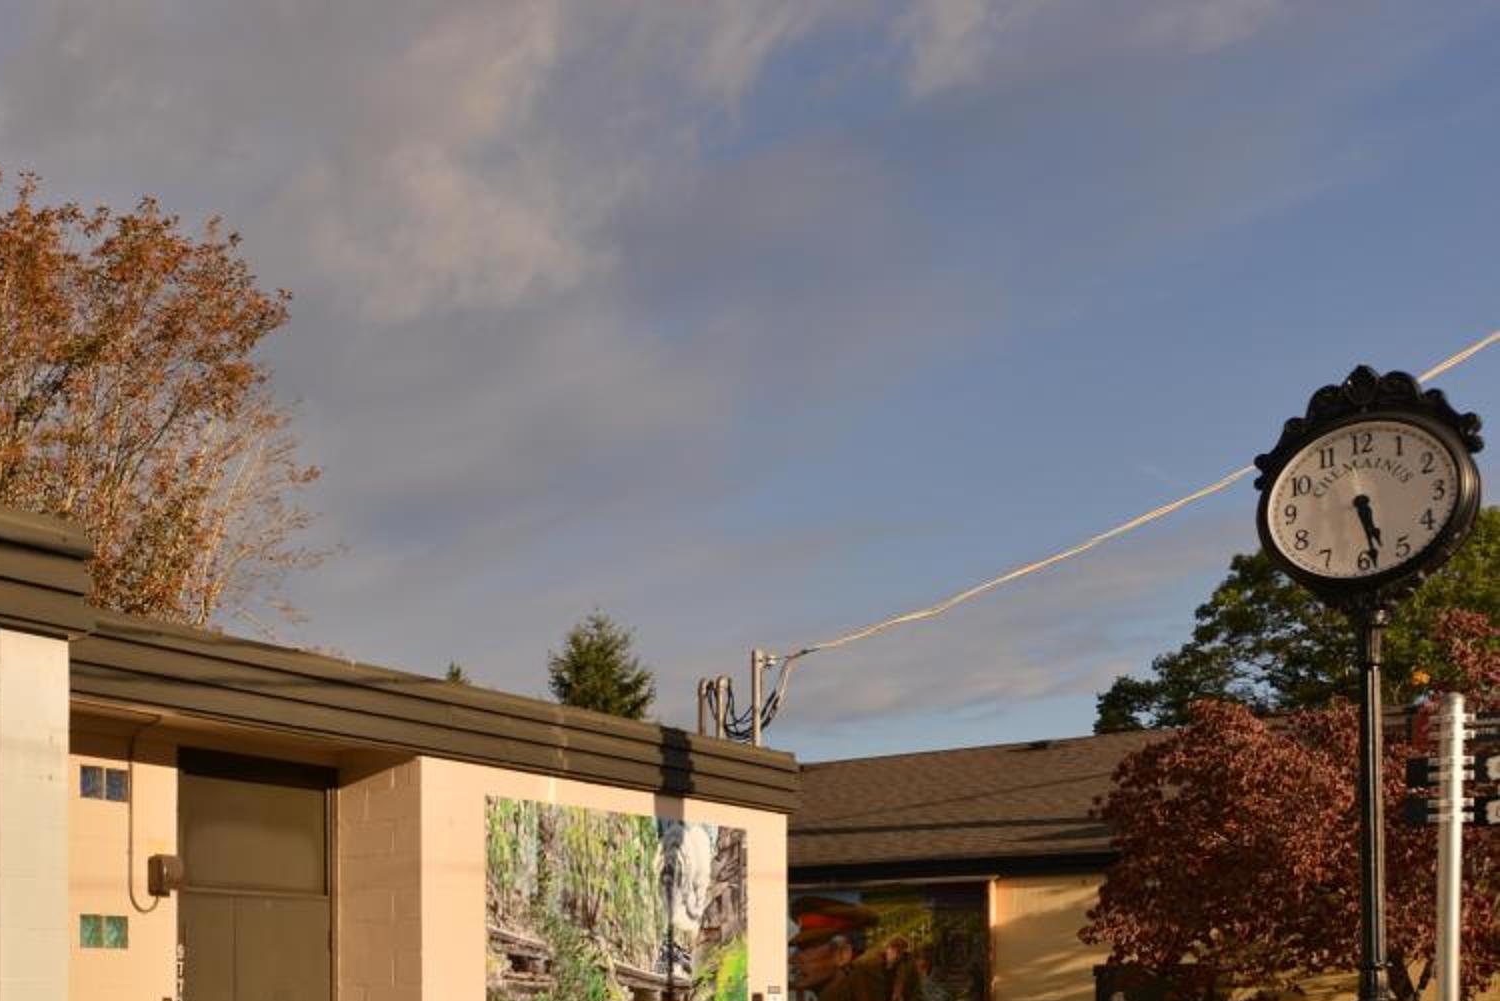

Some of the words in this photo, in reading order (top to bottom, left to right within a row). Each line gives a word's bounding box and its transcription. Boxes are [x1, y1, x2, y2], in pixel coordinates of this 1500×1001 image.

[1351, 432, 1373, 456] 12
[1395, 435, 1403, 457] 1
[1319, 447, 1335, 470] 11
[1421, 451, 1434, 475] 2
[1292, 474, 1311, 498] 10
[1432, 479, 1445, 501] 3
[1284, 504, 1297, 526] 9
[1420, 508, 1435, 531] 4
[1294, 529, 1309, 551] 8
[1395, 533, 1411, 558] 5
[1318, 548, 1332, 569] 7
[1357, 549, 1371, 571] 6
